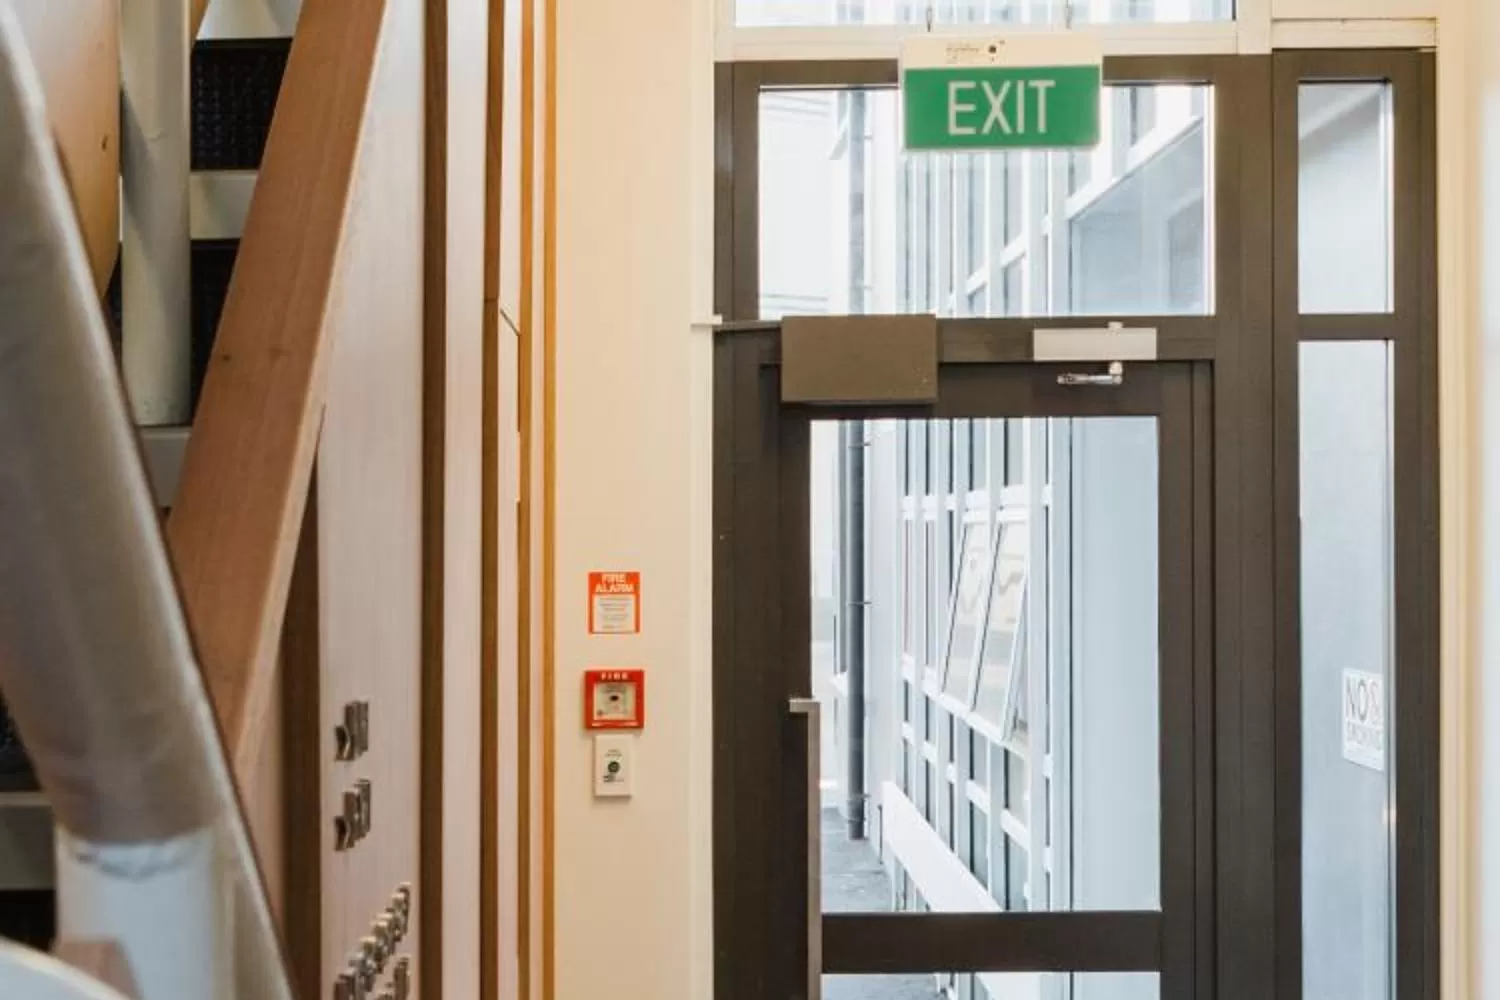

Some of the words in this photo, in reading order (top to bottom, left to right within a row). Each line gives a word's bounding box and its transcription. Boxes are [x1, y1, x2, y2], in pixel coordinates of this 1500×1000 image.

[948, 80, 1055, 135] EXIT
[602, 574, 625, 584] FIRE
[595, 583, 634, 593] ALARM
